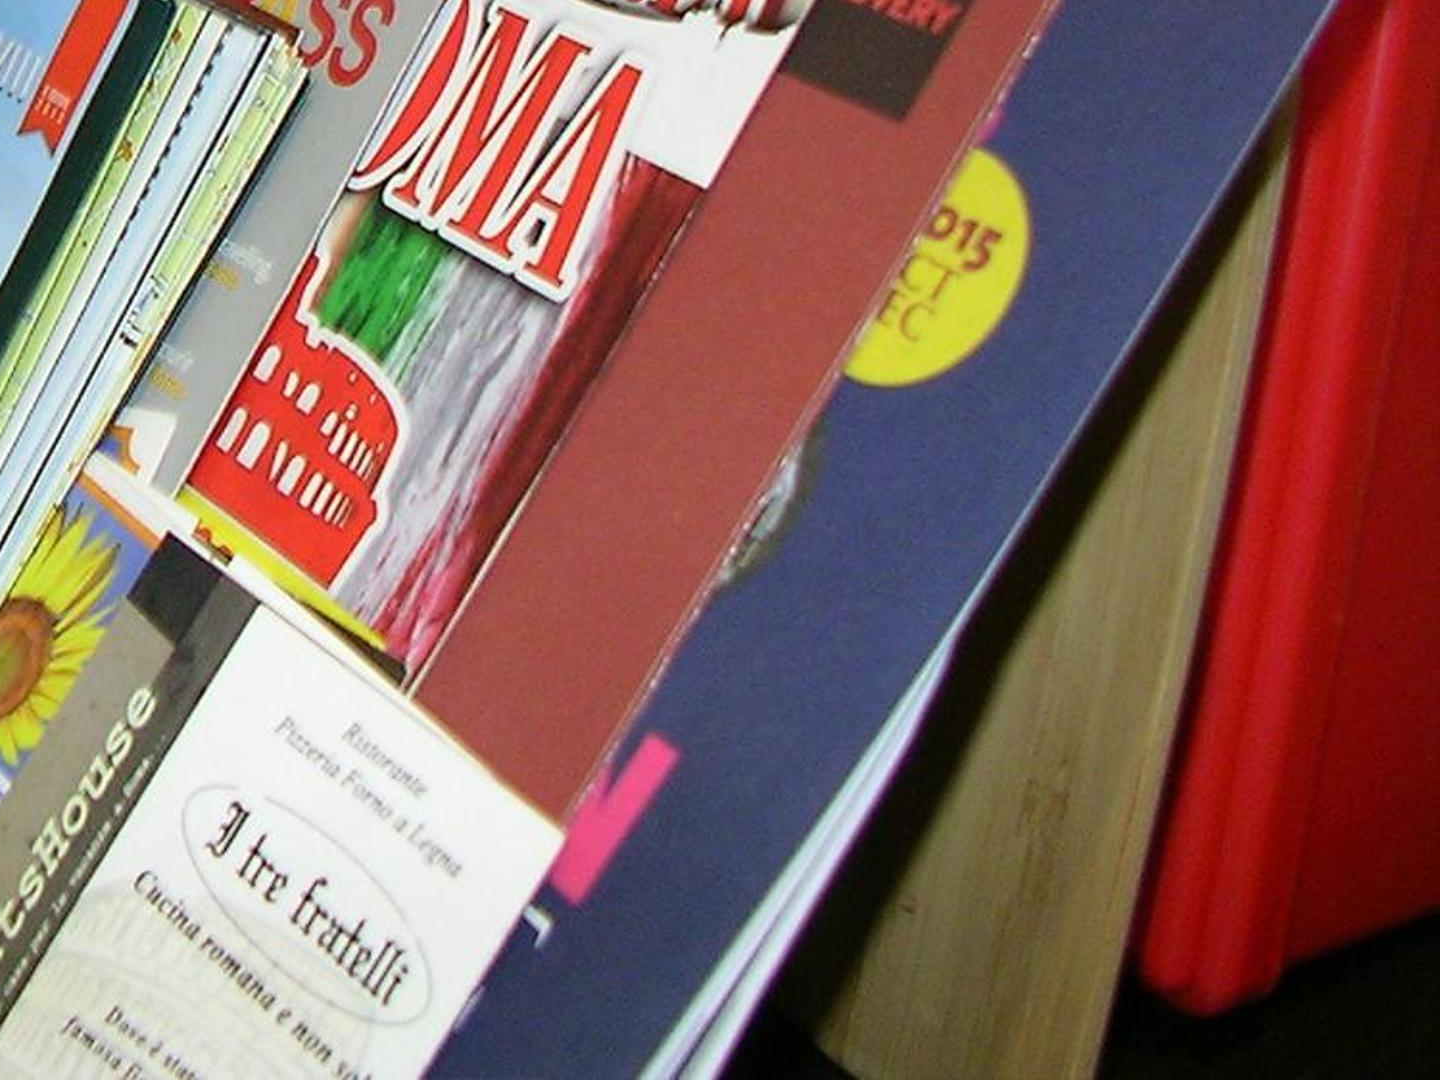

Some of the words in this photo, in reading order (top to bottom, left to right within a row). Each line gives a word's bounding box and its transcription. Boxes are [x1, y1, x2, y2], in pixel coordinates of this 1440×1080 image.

[274, 716, 342, 779] Pizzeria
[340, 769, 394, 821] Forno
[342, 721, 428, 799] Ristorante
[134, 870, 201, 941] Cucina
[200, 936, 276, 1011] romana
[276, 1007, 292, 1025] e
[291, 1021, 333, 1064] non
[237, 834, 288, 902] tre
[291, 876, 408, 1005] fratelli
